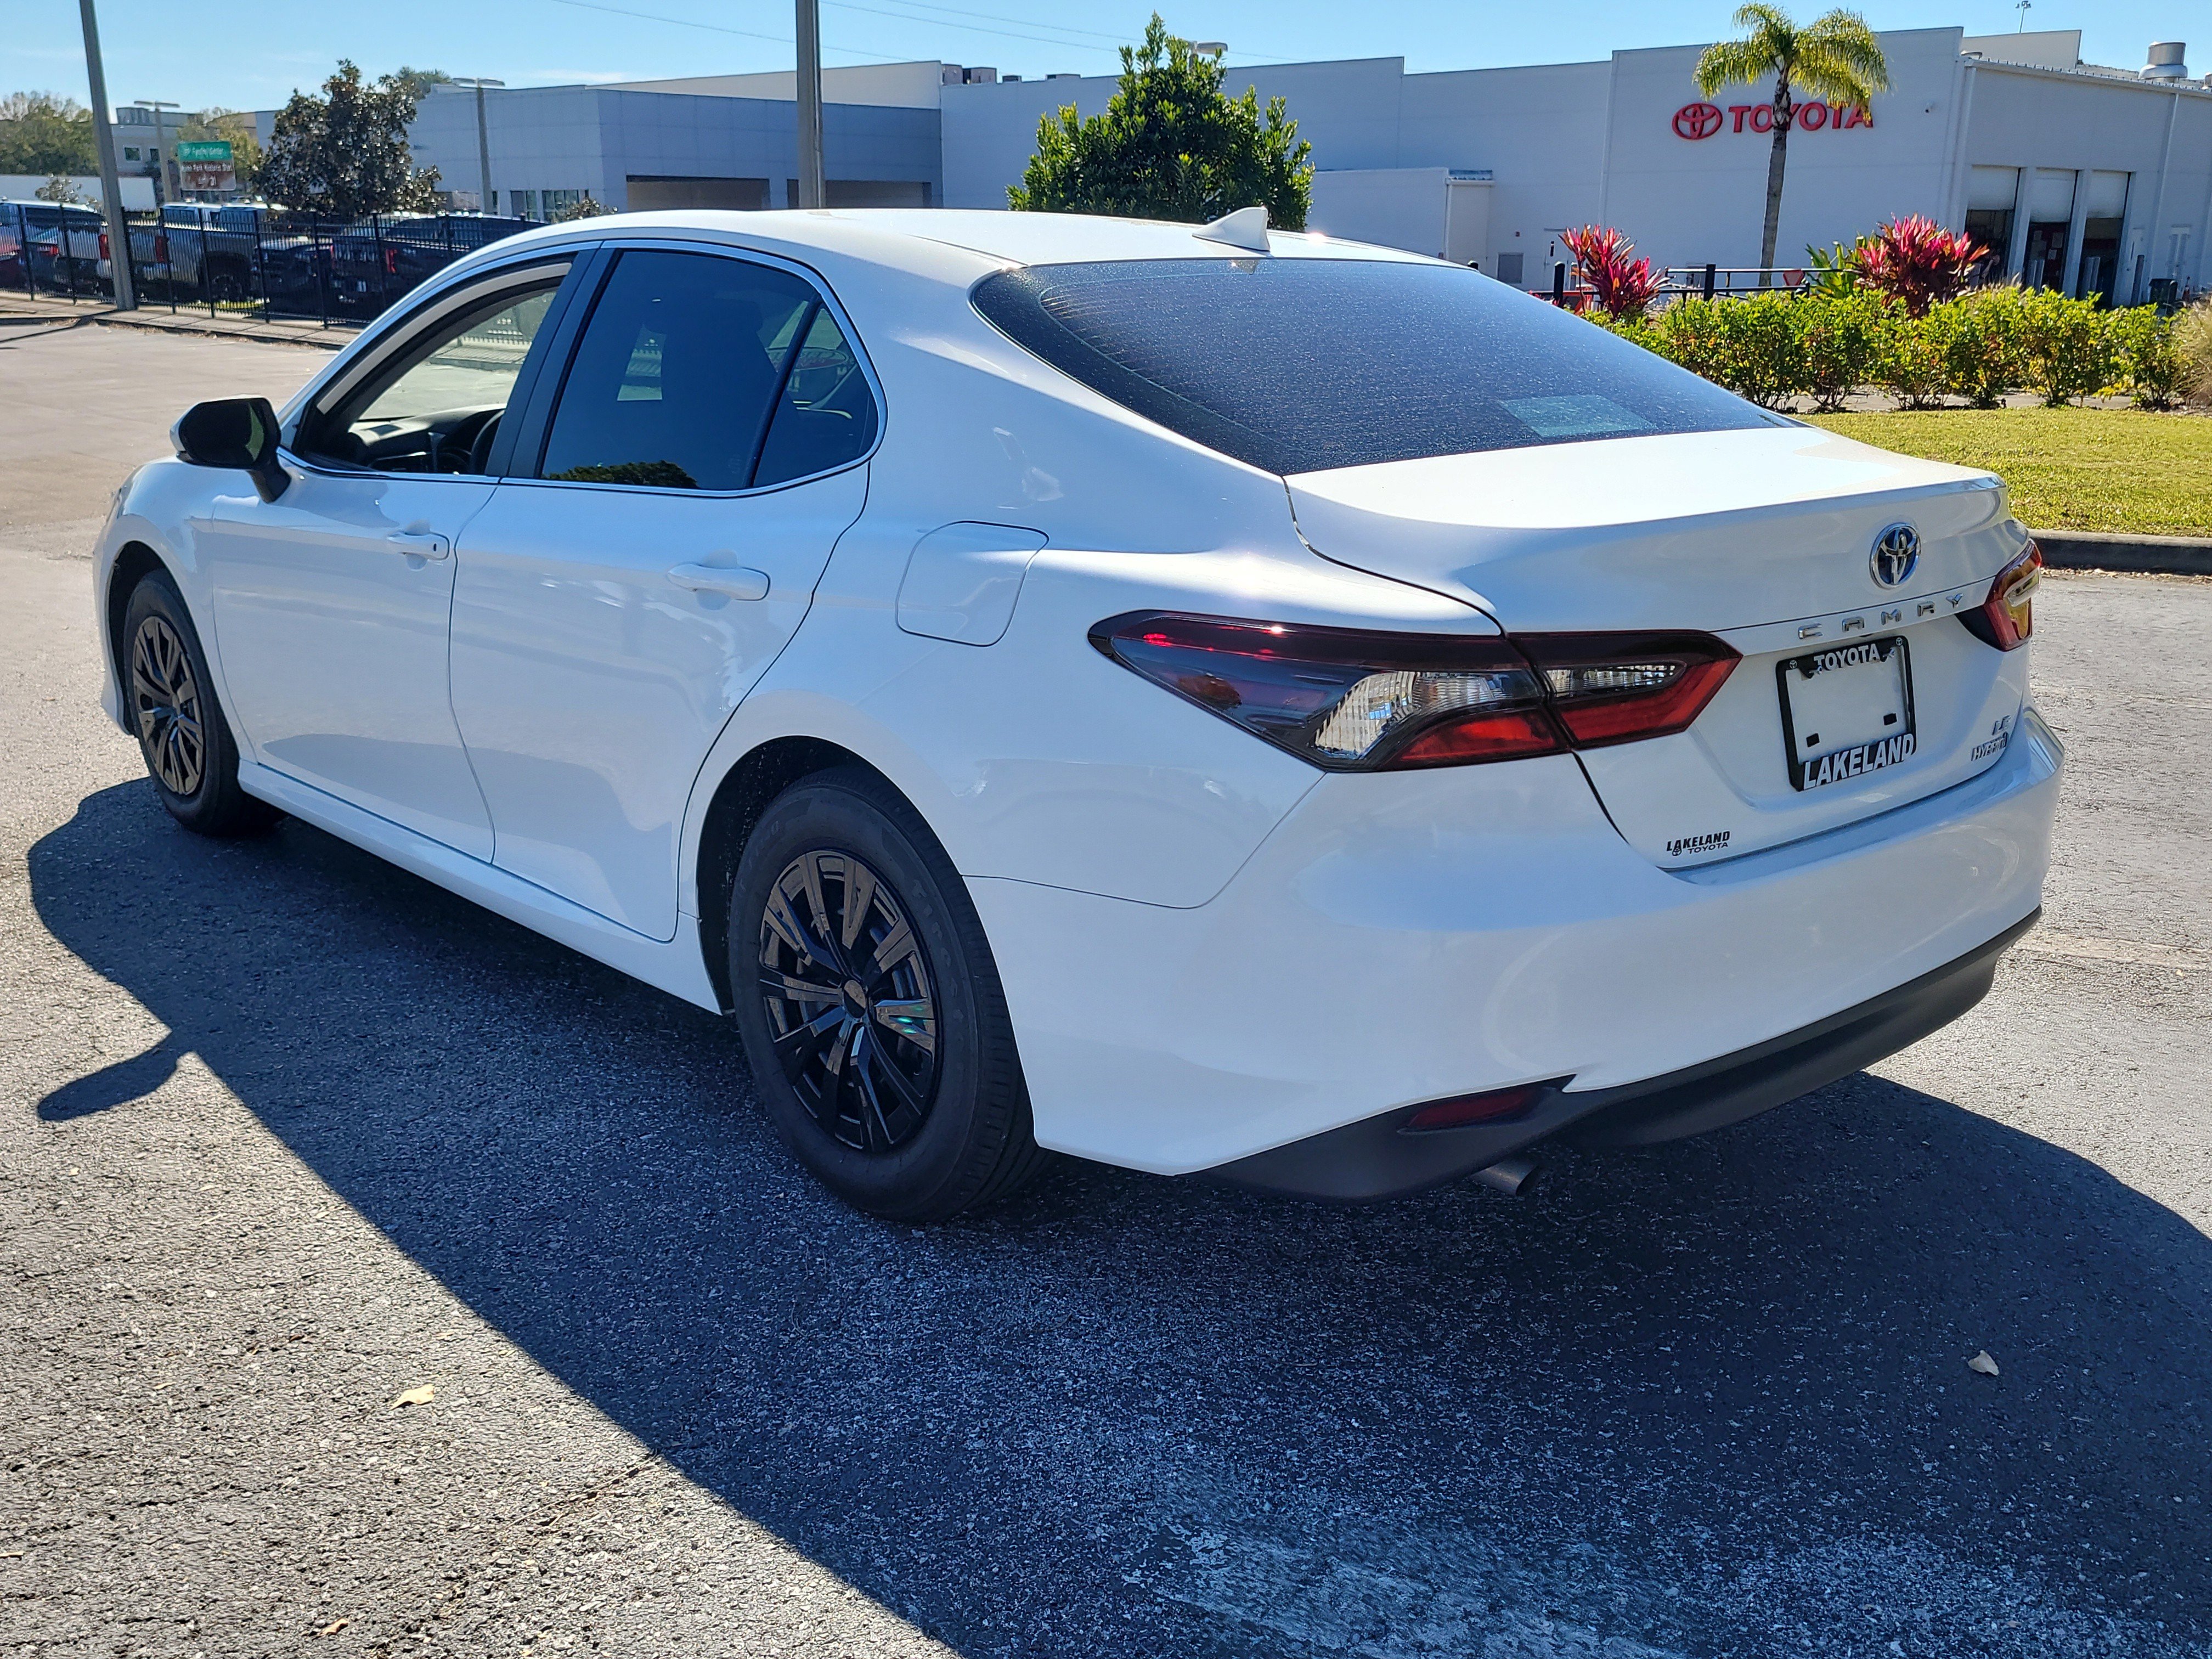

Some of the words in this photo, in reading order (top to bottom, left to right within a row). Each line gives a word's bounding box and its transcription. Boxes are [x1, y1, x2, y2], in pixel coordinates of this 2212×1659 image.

[1798, 593, 1963, 640] CAMRY
[1814, 644, 1881, 670] TOYOTA
[1803, 733, 1914, 790] LAKELAND
[1666, 831, 1730, 851] LAKELAND
[1688, 842, 1728, 854] TOYOTA
